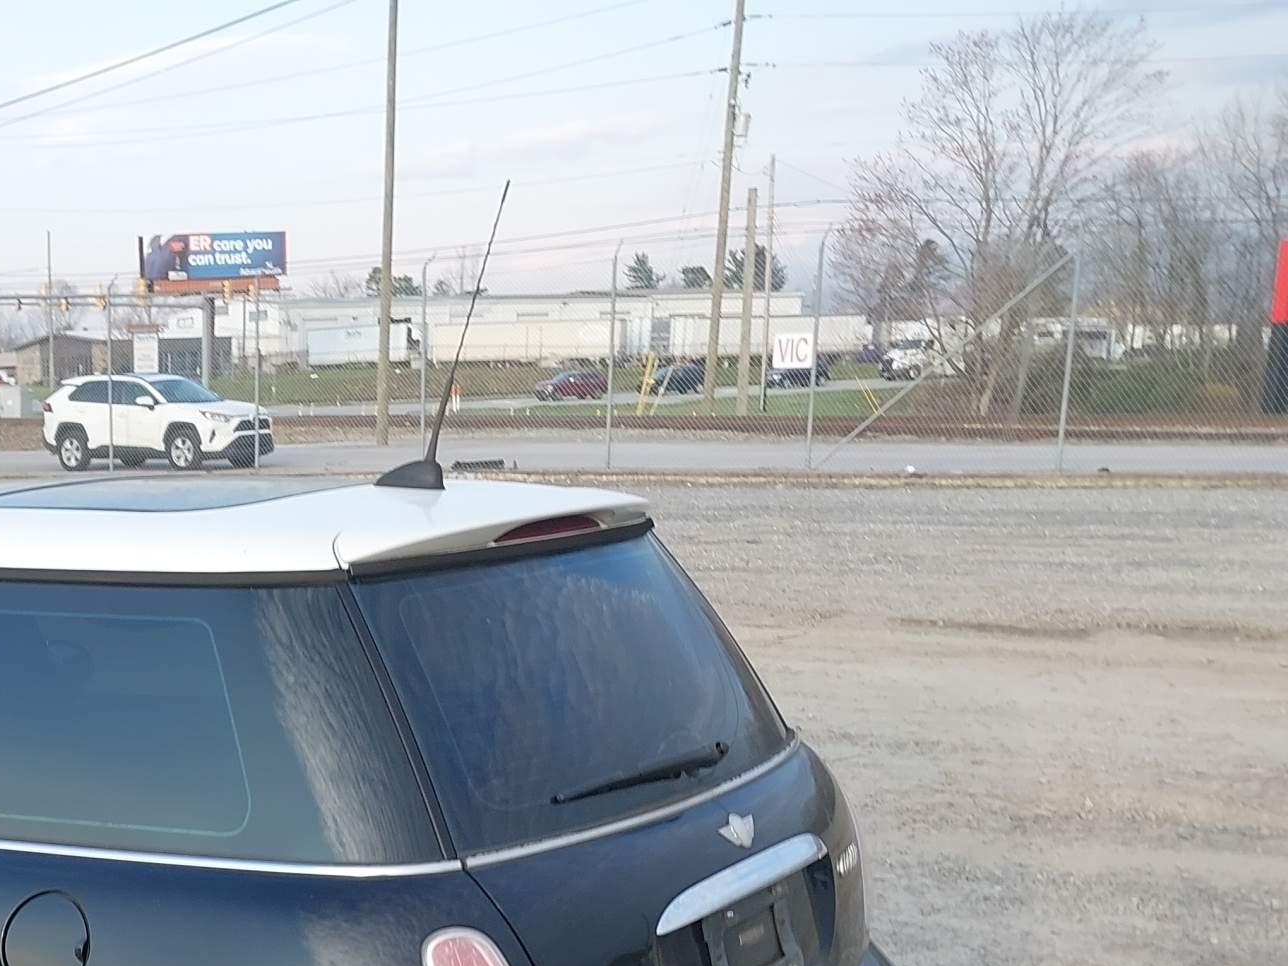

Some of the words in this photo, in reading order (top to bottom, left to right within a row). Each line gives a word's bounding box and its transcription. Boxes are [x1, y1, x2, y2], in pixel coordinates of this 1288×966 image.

[189, 235, 211, 250] ER
[213, 239, 244, 251] care
[245, 238, 273, 252] you
[188, 254, 215, 266] can
[216, 252, 251, 265] trust.
[778, 337, 808, 362] VIC
